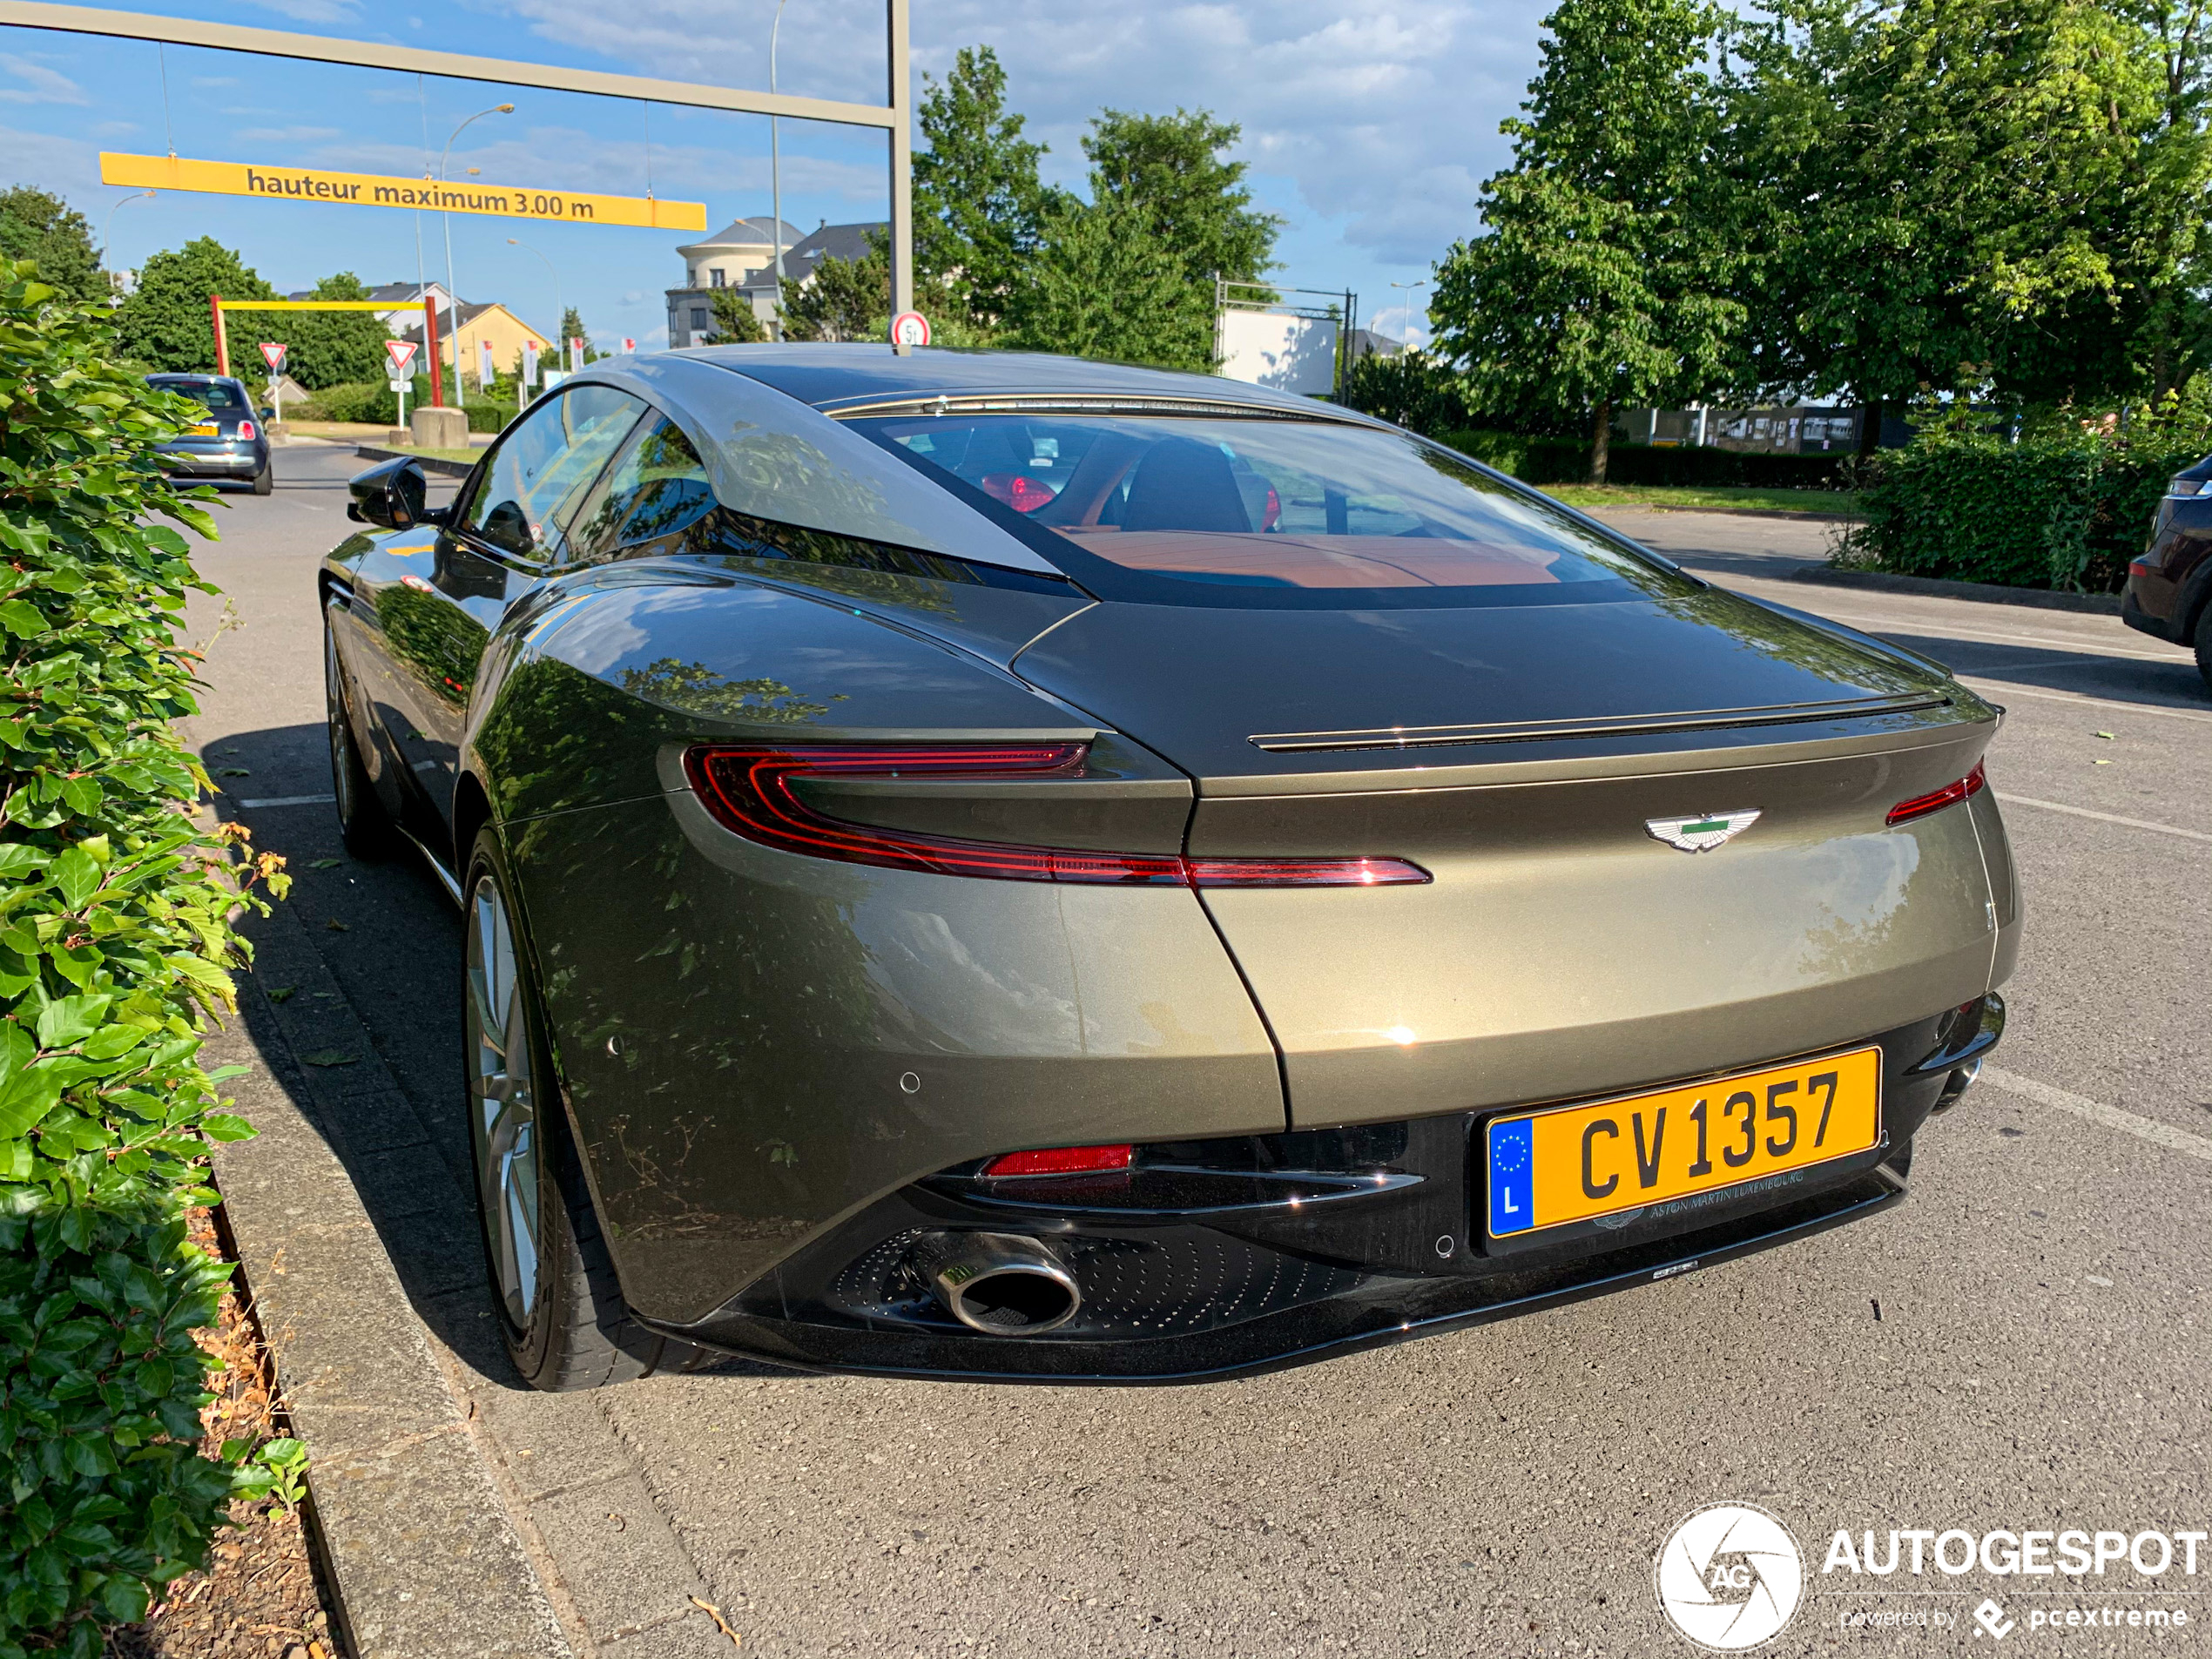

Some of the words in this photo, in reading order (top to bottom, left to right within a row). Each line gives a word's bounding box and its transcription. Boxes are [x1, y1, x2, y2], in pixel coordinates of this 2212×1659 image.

[246, 169, 361, 200] hauteur
[374, 185, 508, 212] maximum
[514, 192, 563, 216] 3.00
[571, 200, 594, 219] m
[1581, 1106, 1667, 1200] CV
[1688, 1070, 1838, 1177] 1357
[1504, 1186, 1519, 1214] L
[1650, 1201, 1690, 1218] ASTON
[1690, 1190, 1735, 1209] MARTIN
[1733, 1170, 1804, 1197] LUXEMBOURG
